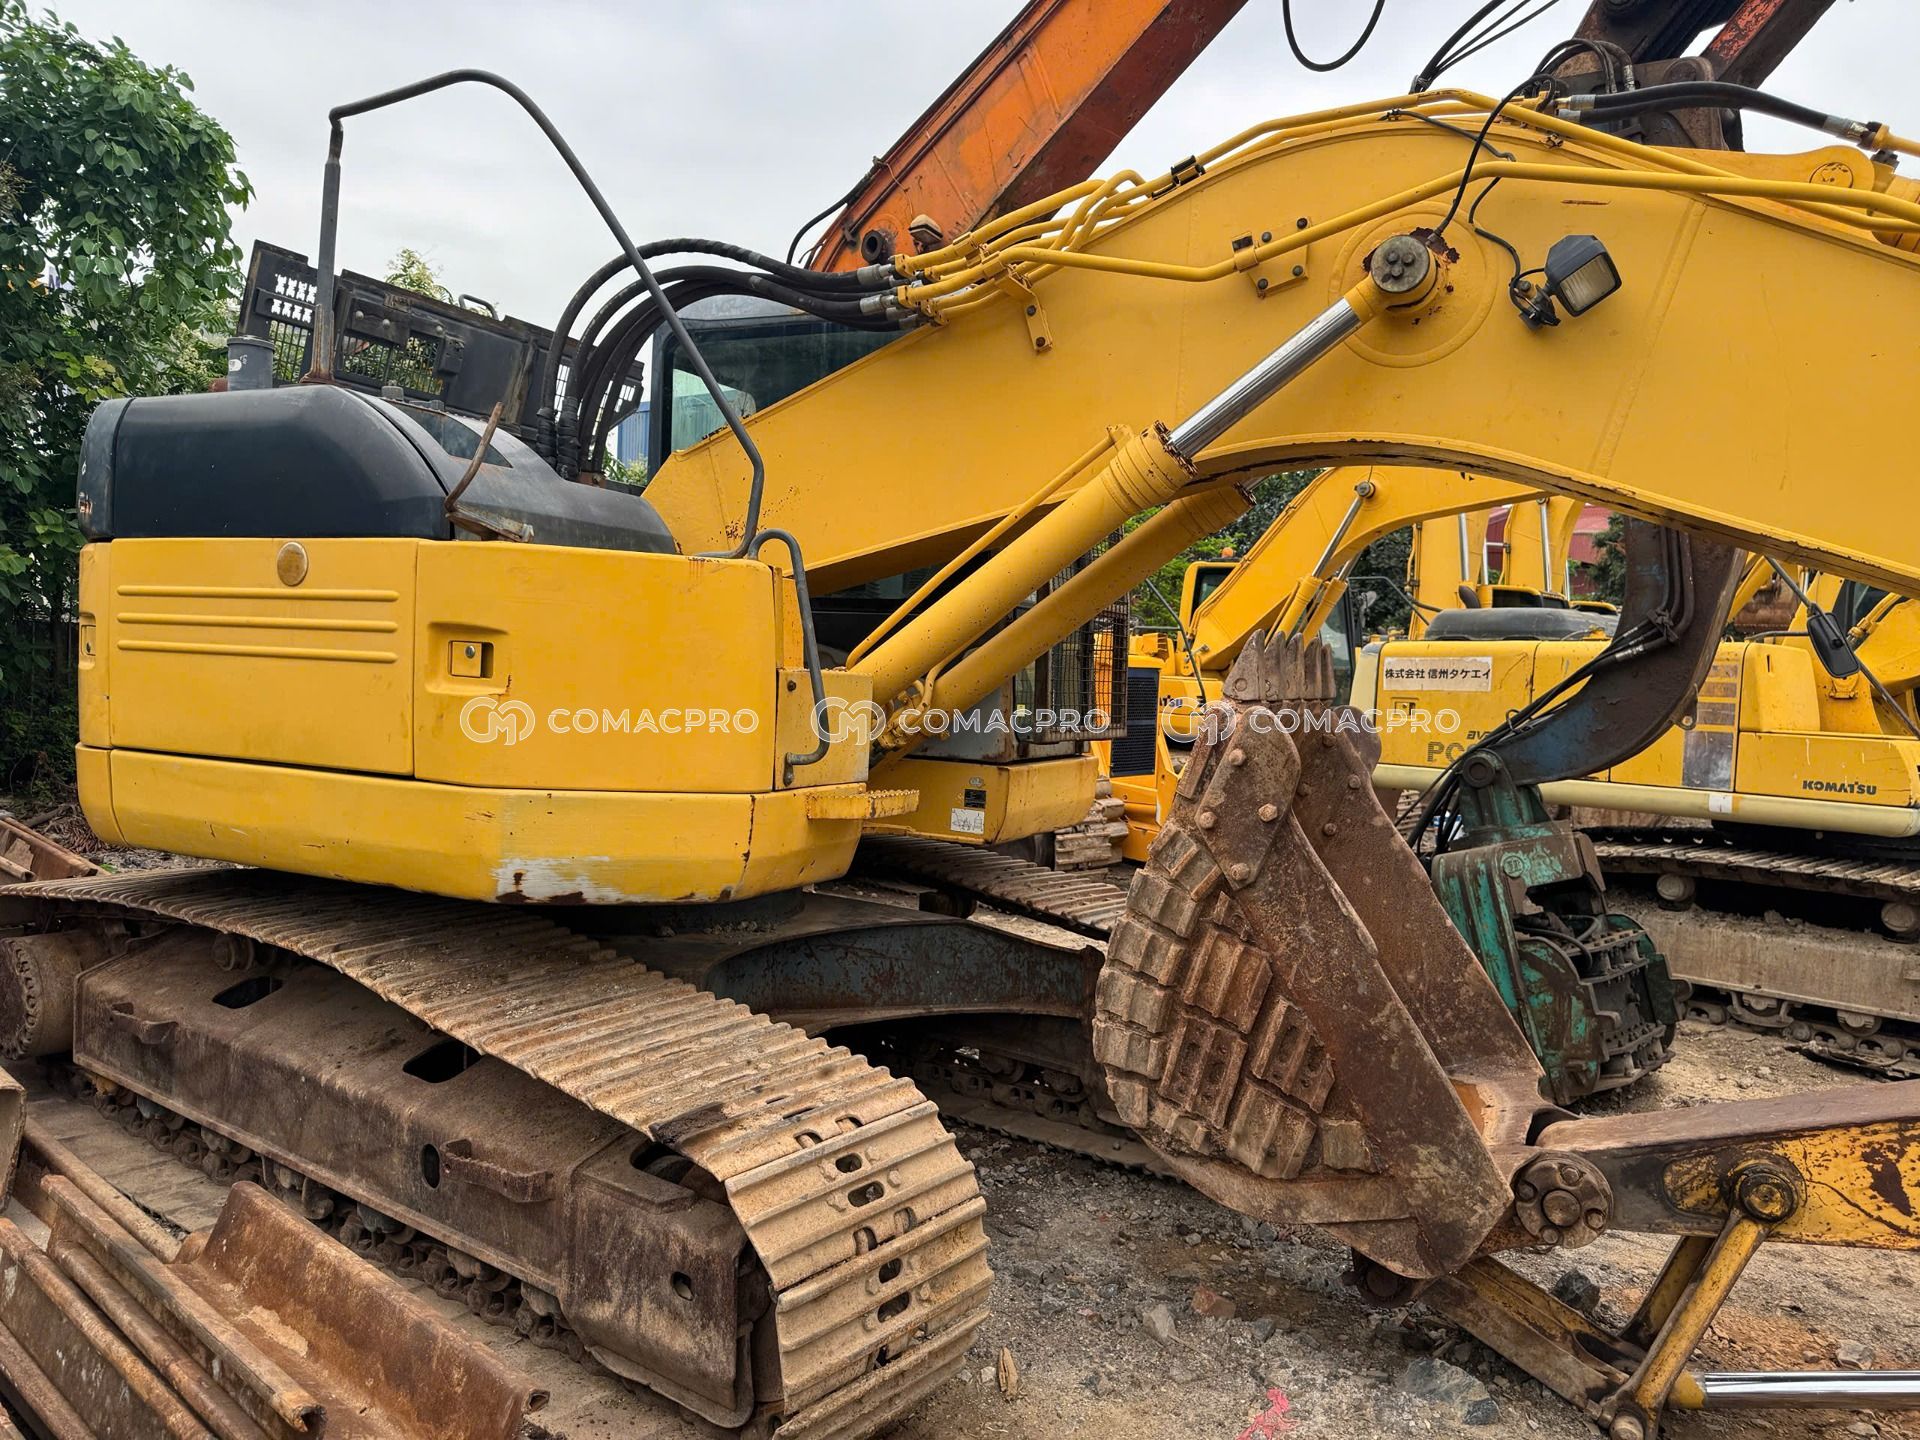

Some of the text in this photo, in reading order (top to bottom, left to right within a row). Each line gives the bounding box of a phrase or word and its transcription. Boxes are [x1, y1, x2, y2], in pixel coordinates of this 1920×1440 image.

[1385, 668, 1491, 679] 株式会社 信州タケエイ
[1802, 780, 1877, 795] KOMATSU
